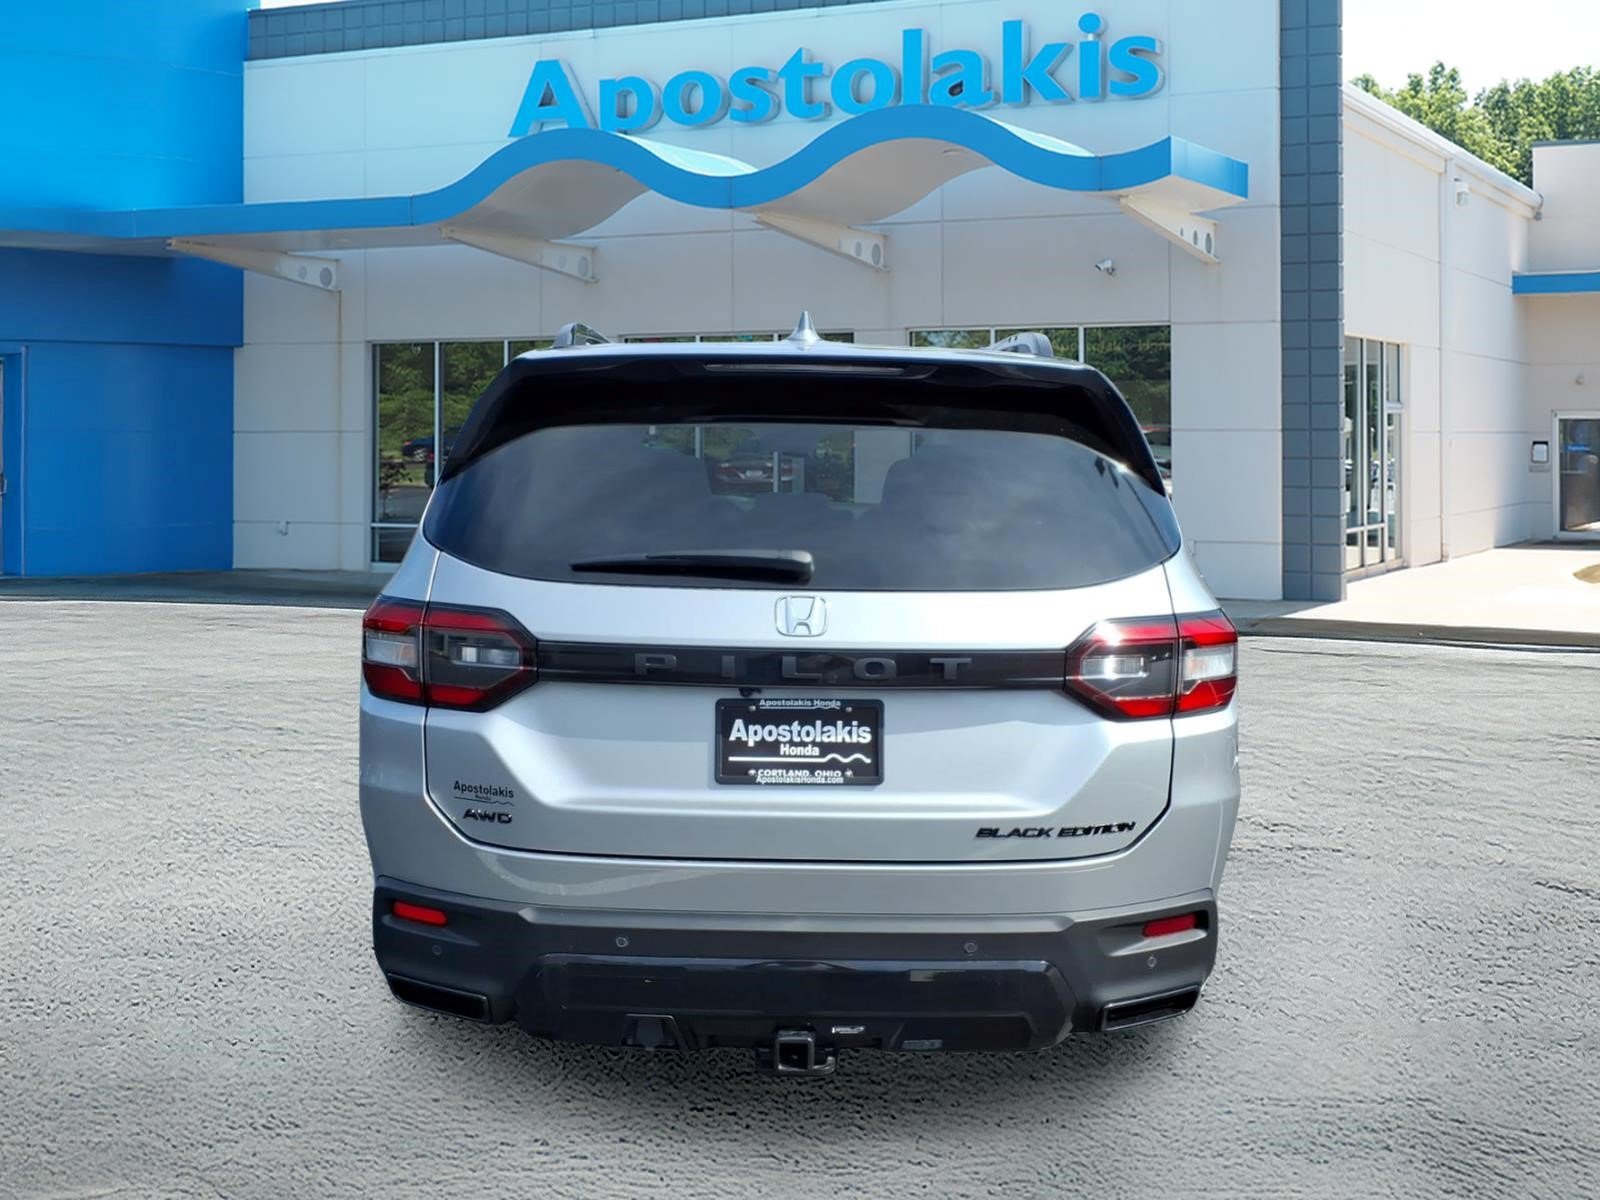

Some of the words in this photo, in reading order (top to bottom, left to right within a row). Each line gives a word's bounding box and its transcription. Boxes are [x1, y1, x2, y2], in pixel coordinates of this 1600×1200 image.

[508, 12, 1165, 138] Apostolakis
[634, 653, 972, 681] PILOT
[759, 699, 812, 708] Apostolakis
[813, 699, 841, 708] Honda
[729, 719, 872, 747] Apostolakis
[780, 744, 820, 756] Honda
[814, 769, 842, 778] OHIO
[453, 780, 515, 799] Apostolakis
[463, 808, 513, 824] AWD
[975, 827, 1055, 838] BLACK
[1057, 821, 1136, 837] EDITION
